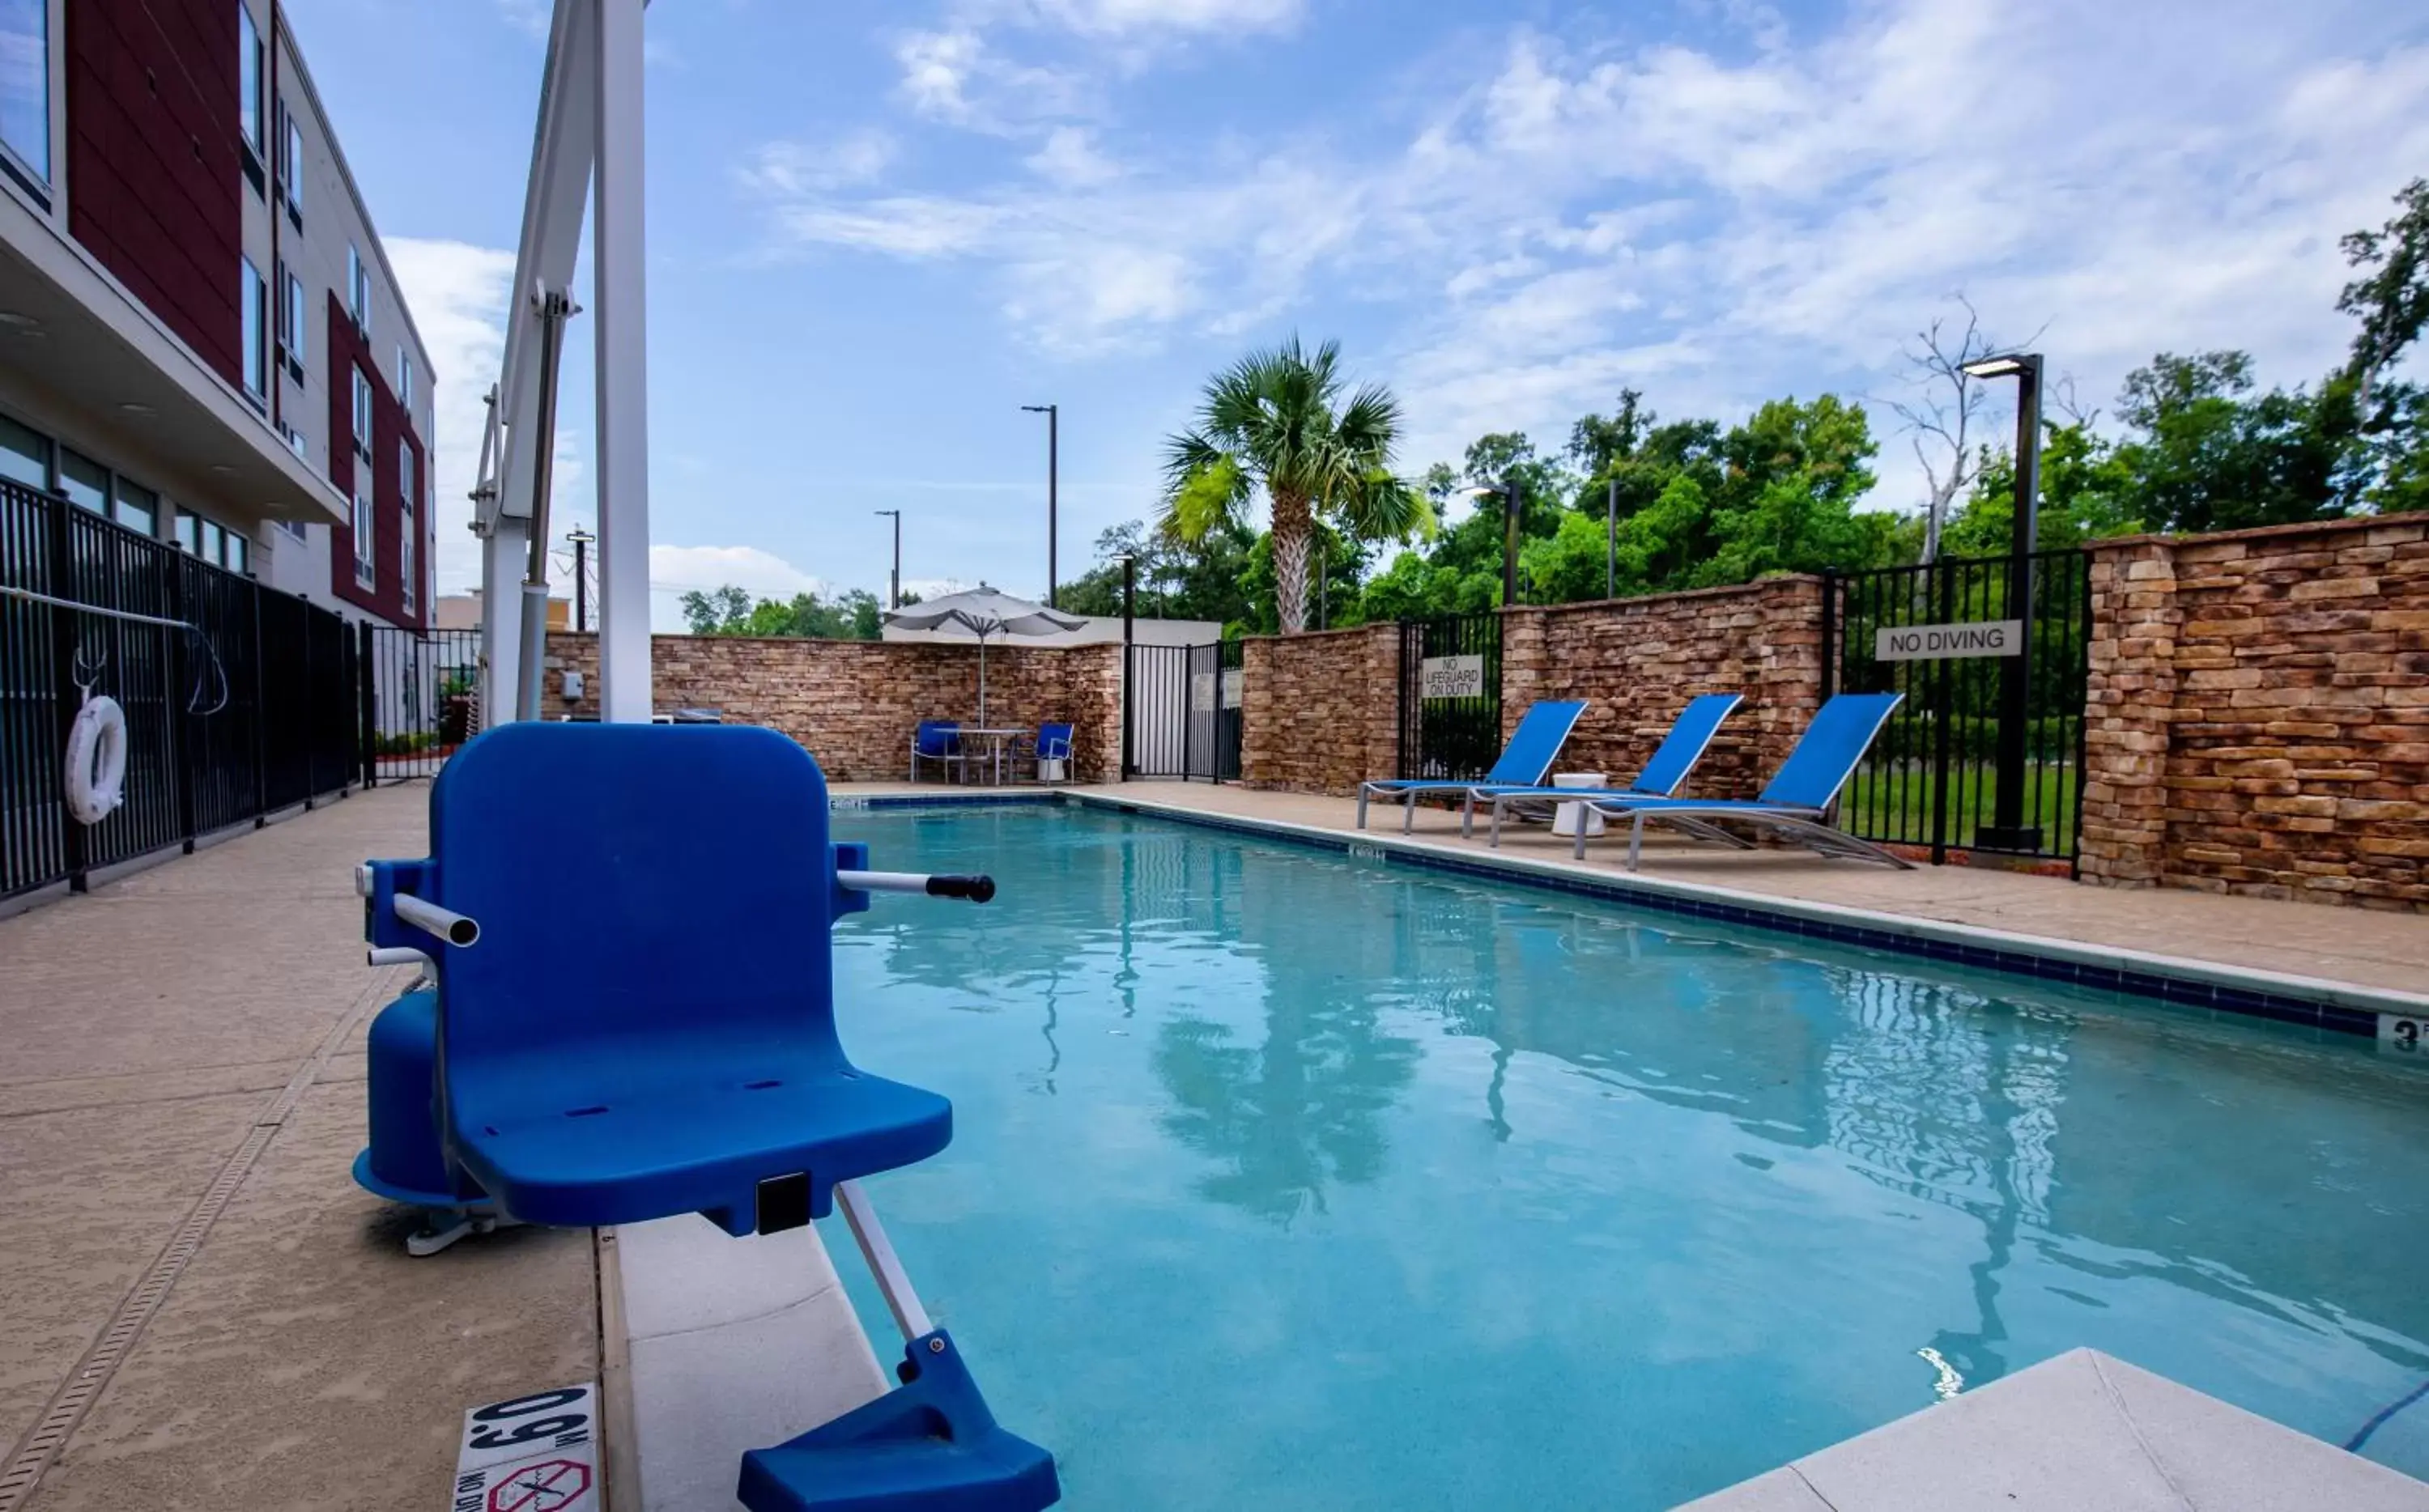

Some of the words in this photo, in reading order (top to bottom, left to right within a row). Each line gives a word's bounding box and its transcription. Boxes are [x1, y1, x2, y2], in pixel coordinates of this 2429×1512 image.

[1891, 634, 1921, 653] NO
[1928, 628, 2005, 651] DIVING
[1442, 658, 1457, 670] NO
[1430, 683, 1444, 695] ON
[1446, 682, 1473, 695] DUTY
[457, 1471, 487, 1493] NO
